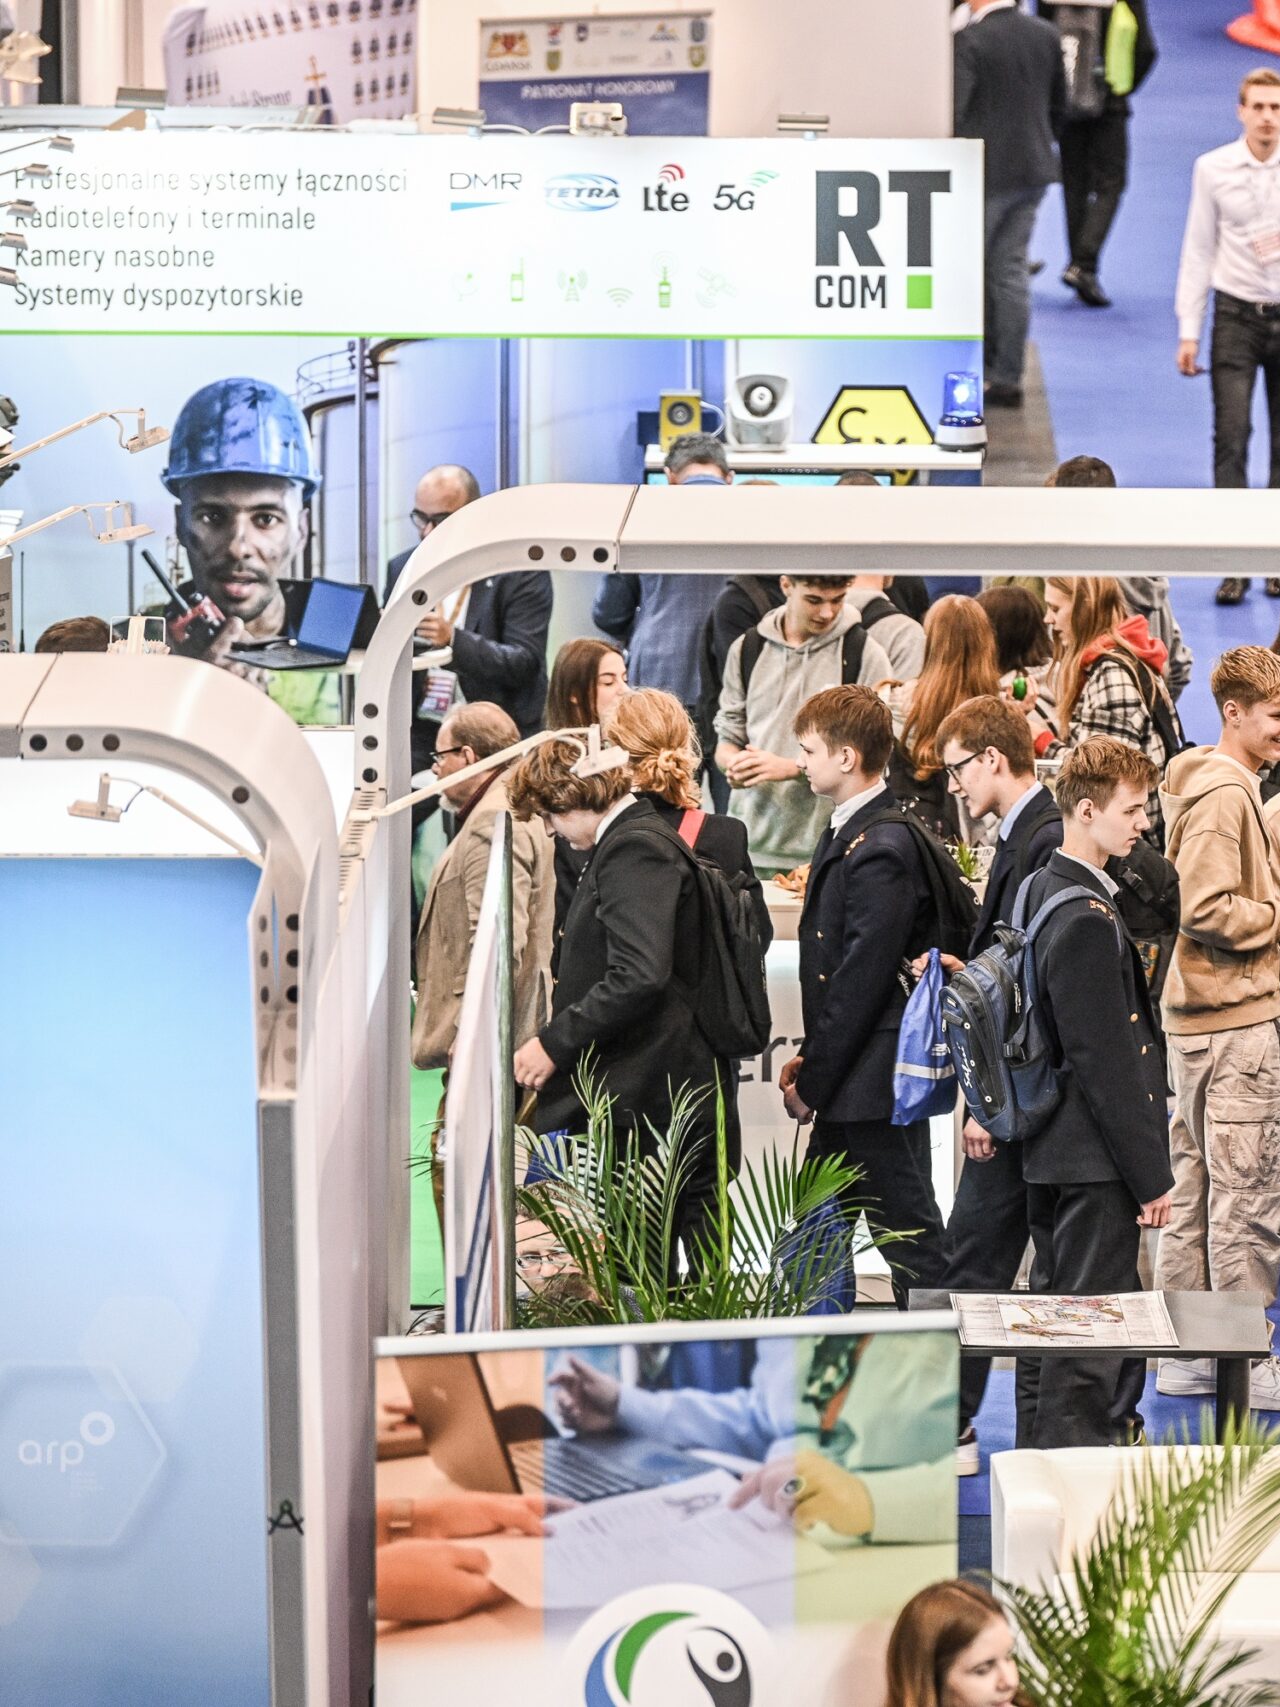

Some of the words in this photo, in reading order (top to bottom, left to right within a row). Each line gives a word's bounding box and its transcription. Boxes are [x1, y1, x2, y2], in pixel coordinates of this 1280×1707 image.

[189, 170, 288, 196] systemy
[297, 168, 408, 197] łączności
[449, 171, 523, 191] DMR
[544, 186, 621, 199] TETRA
[712, 184, 756, 212] 5G
[187, 204, 192, 229] i
[201, 204, 317, 230] terminale
[815, 170, 952, 267] RT
[15, 247, 106, 273] Kamery
[114, 244, 215, 268] nasobne
[14, 281, 115, 312] Systemy
[123, 283, 304, 311] dyspozytorskie
[815, 274, 887, 309] COM
